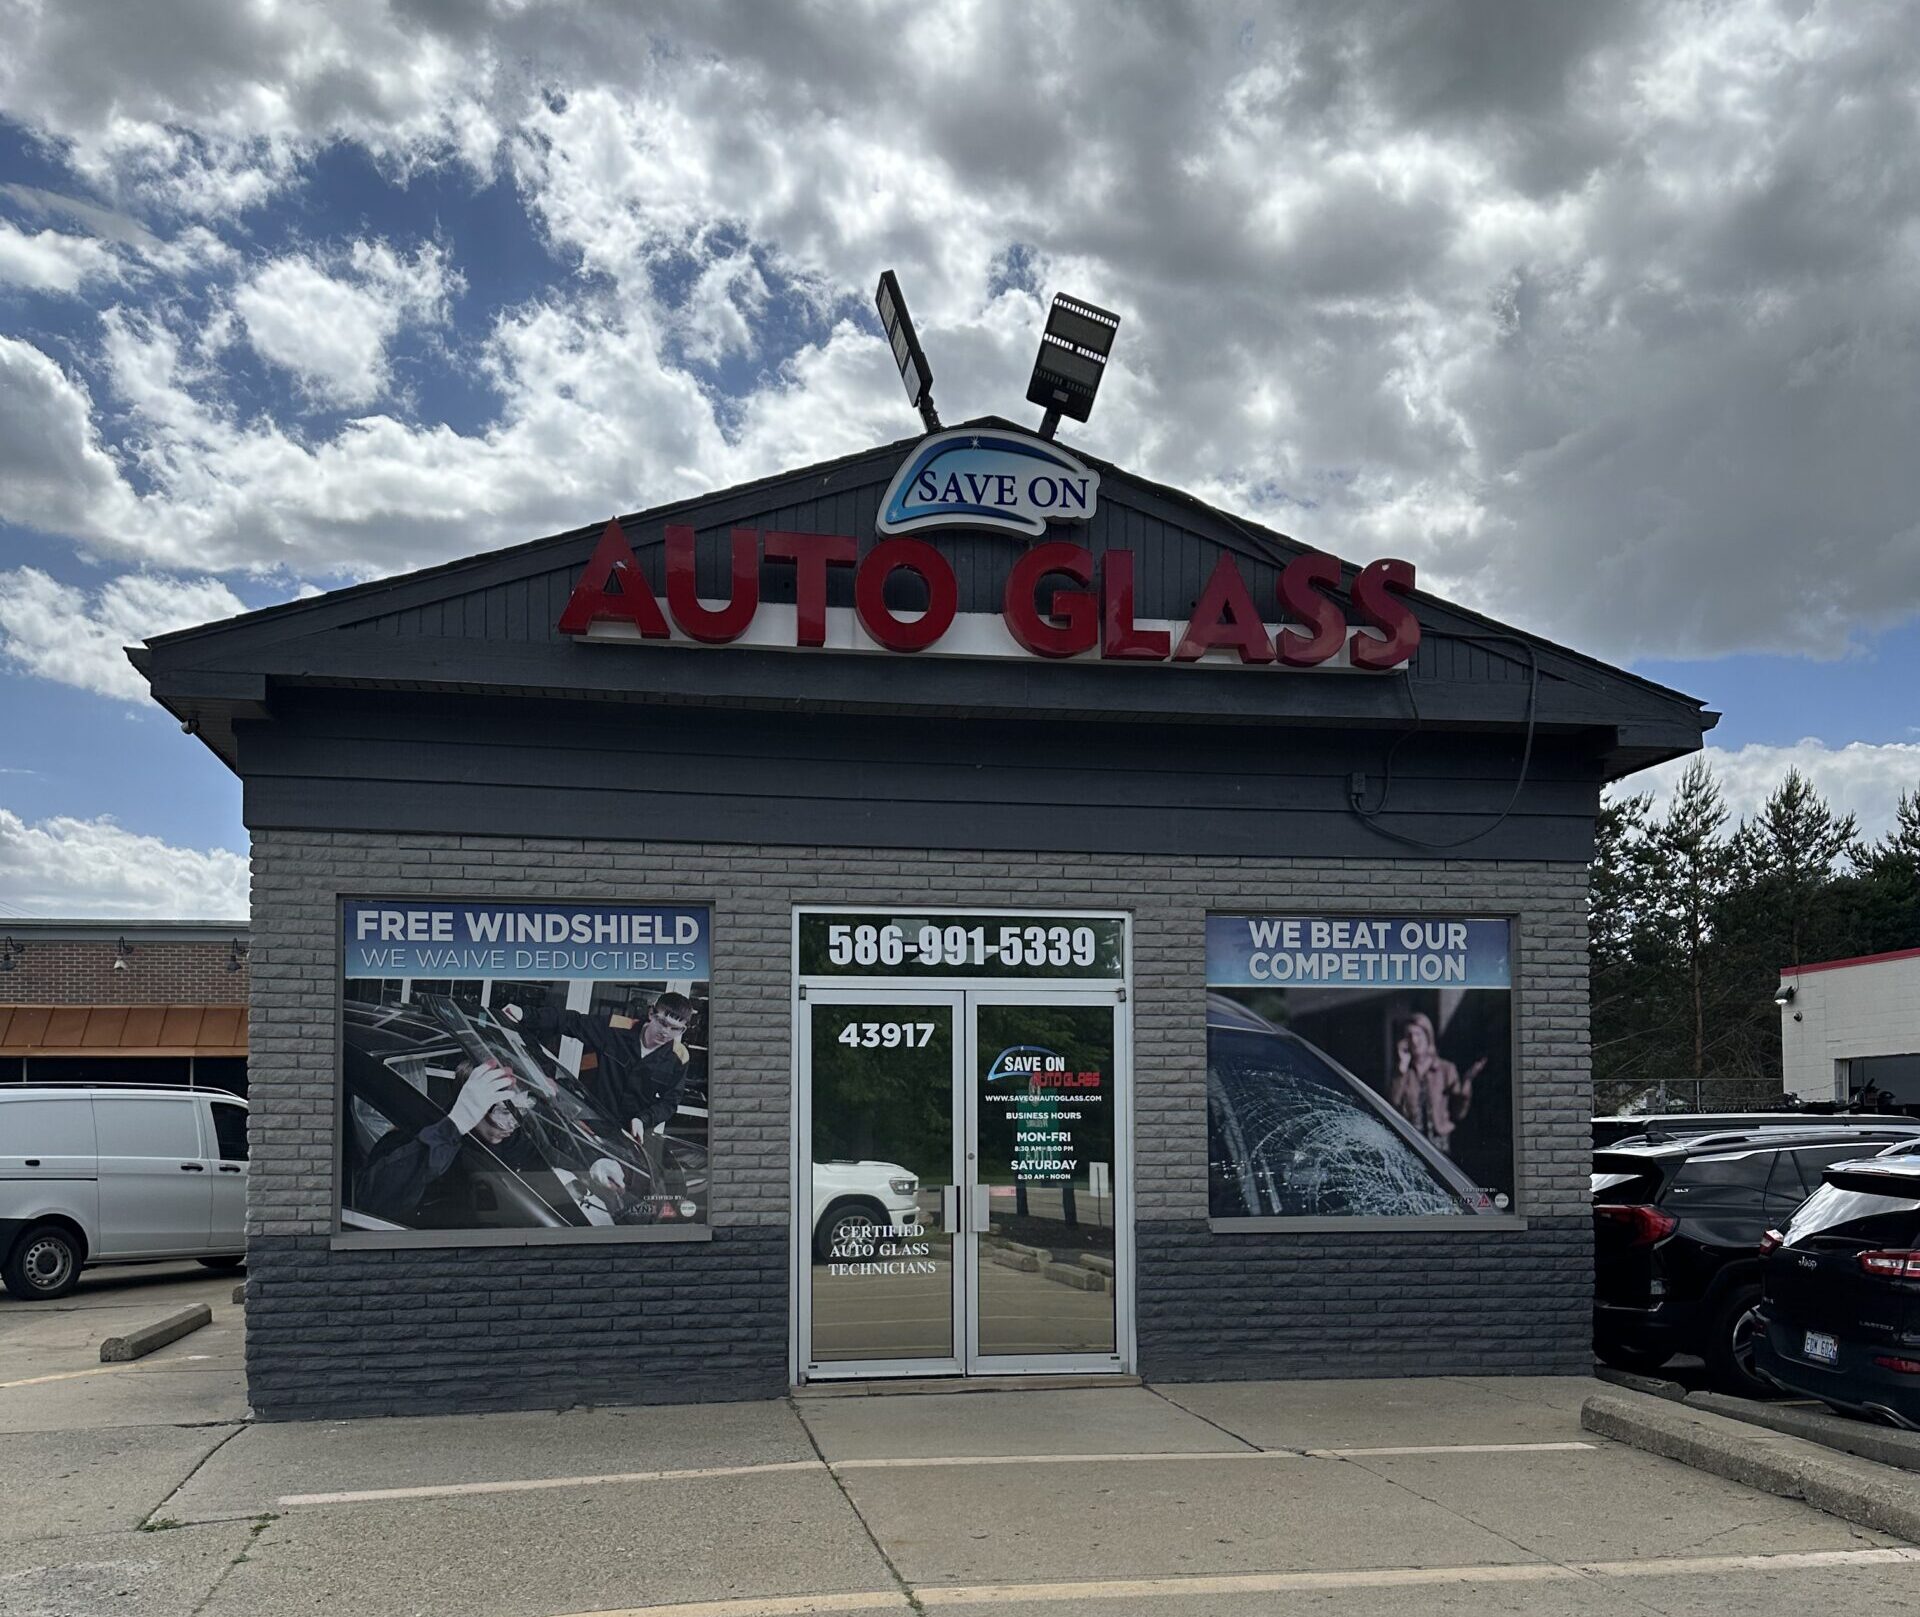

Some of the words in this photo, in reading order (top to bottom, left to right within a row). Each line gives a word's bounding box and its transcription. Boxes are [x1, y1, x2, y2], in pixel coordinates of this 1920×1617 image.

[918, 470, 1018, 506] SAVE
[1028, 475, 1089, 509] ON
[558, 516, 959, 653] AUTO
[1005, 540, 1423, 673] GLASS
[357, 910, 454, 941] FREE
[465, 912, 700, 945] WINDSHIELD
[1249, 920, 1301, 949] WE
[1311, 921, 1391, 950] BEAT
[1400, 922, 1468, 950] OUR
[828, 925, 1096, 967] 586-991-5339
[361, 948, 407, 968] WE
[415, 949, 505, 969] WAIVE
[516, 950, 696, 971] DEDUCTIBLES
[1249, 952, 1466, 982] COMPETITION
[838, 1022, 936, 1048] 43917
[1004, 1056, 1041, 1072] SAVE
[1045, 1056, 1065, 1072] ON
[1032, 1071, 1062, 1087] AUTO
[1063, 1071, 1100, 1087] GLASS
[1016, 1132, 1071, 1142] MON-FRI
[1011, 1160, 1078, 1170] SATURDAY
[840, 1225, 925, 1238] CERTIFIED
[829, 1243, 874, 1257] AUTO
[879, 1243, 929, 1256] GLASS
[828, 1261, 937, 1275] TECHNICIANS
